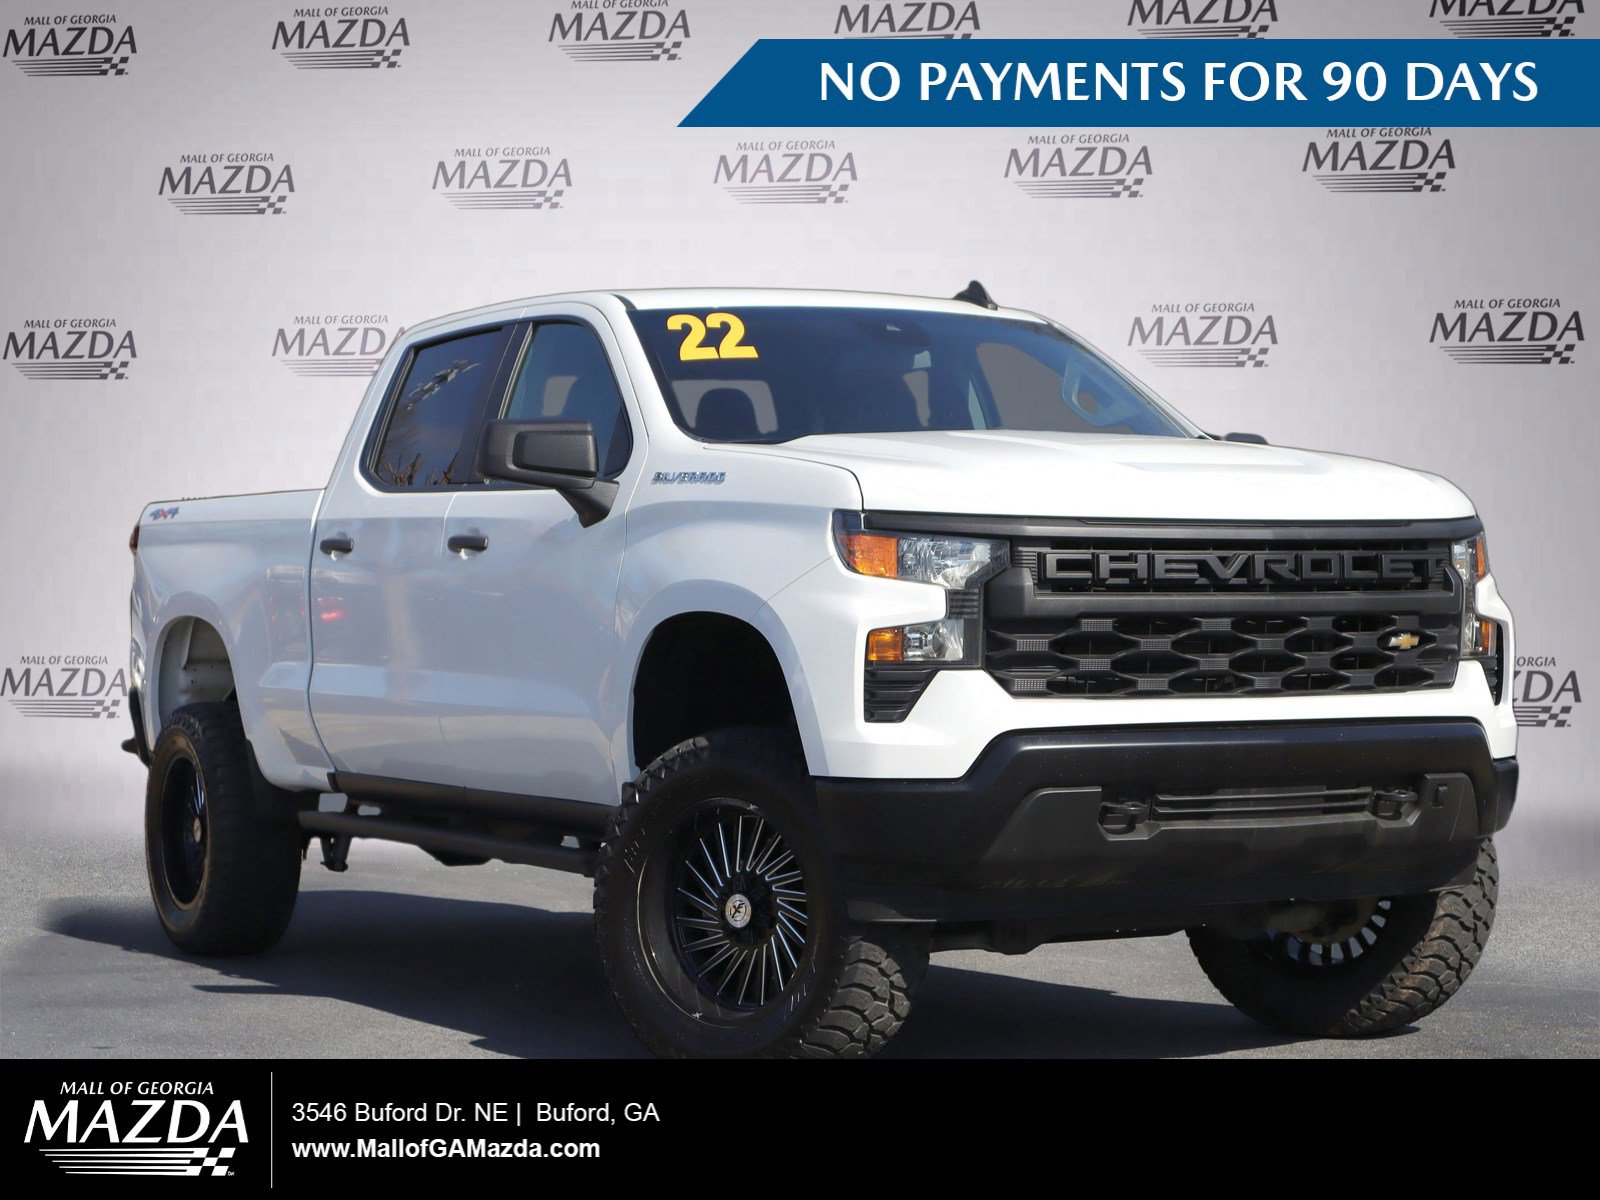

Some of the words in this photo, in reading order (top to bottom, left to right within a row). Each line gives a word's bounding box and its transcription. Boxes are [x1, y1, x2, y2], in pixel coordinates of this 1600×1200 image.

[293, 8, 320, 18] MALL
[324, 7, 339, 17] OF
[341, 6, 389, 17] GEORGIA
[570, 0, 599, 9] MALL
[602, 0, 617, 9] OF
[620, 0, 669, 8] GEORGIA
[834, 0, 981, 34] MAZDA
[1127, 0, 1278, 26] MAZDA
[24, 16, 51, 26] MALL
[53, 15, 68, 25] OF
[70, 14, 117, 24] GEORGIA
[271, 17, 410, 50] MAZDA
[548, 9, 691, 42] MAZDA
[2, 25, 137, 57] MAZDA
[736, 141, 764, 151] MALL
[768, 140, 783, 151] OF
[785, 139, 836, 150] GEORGIA
[1027, 135, 1057, 145] MALL
[1060, 134, 1076, 144] OF
[1079, 133, 1130, 144] GEORGIA
[1326, 128, 1357, 138] MALL
[1360, 127, 1377, 138] OF
[1379, 126, 1432, 137] GEORGIA
[180, 154, 207, 163] MALL
[210, 153, 224, 163] OF
[227, 152, 274, 163] GEORGIA
[454, 148, 481, 158] MALL
[485, 147, 500, 157] OF
[502, 146, 551, 157] GEORGIA
[1003, 145, 1153, 178] MAZDA
[1302, 138, 1456, 172] MAZDA
[158, 164, 295, 195] MAZDA
[432, 158, 572, 190] MAZDA
[713, 152, 858, 184] MAZDA
[1151, 303, 1181, 313] MALL
[1184, 303, 1200, 313] OF
[1203, 302, 1255, 312] GEORGIA
[1454, 299, 1485, 309] MALL
[1488, 299, 1505, 309] OF
[1507, 298, 1561, 308] GEORGIA
[24, 319, 51, 329] MALL
[53, 318, 68, 328] OF
[70, 318, 117, 328] GEORGIA
[293, 315, 321, 325] MALL
[324, 314, 339, 325] OF
[341, 313, 389, 324] GEORGIA
[1127, 315, 1278, 346] MAZDA
[1429, 310, 1585, 343] MAZDA
[2, 330, 137, 360] MAZDA
[666, 312, 759, 361] 22
[1041, 552, 1446, 582] CHEVROLET
[20, 655, 46, 665] MALL
[49, 655, 62, 665] OF
[64, 655, 108, 665] GEORGIA
[1516, 656, 1556, 667] ORGIA
[0, 667, 128, 697] MAZDA
